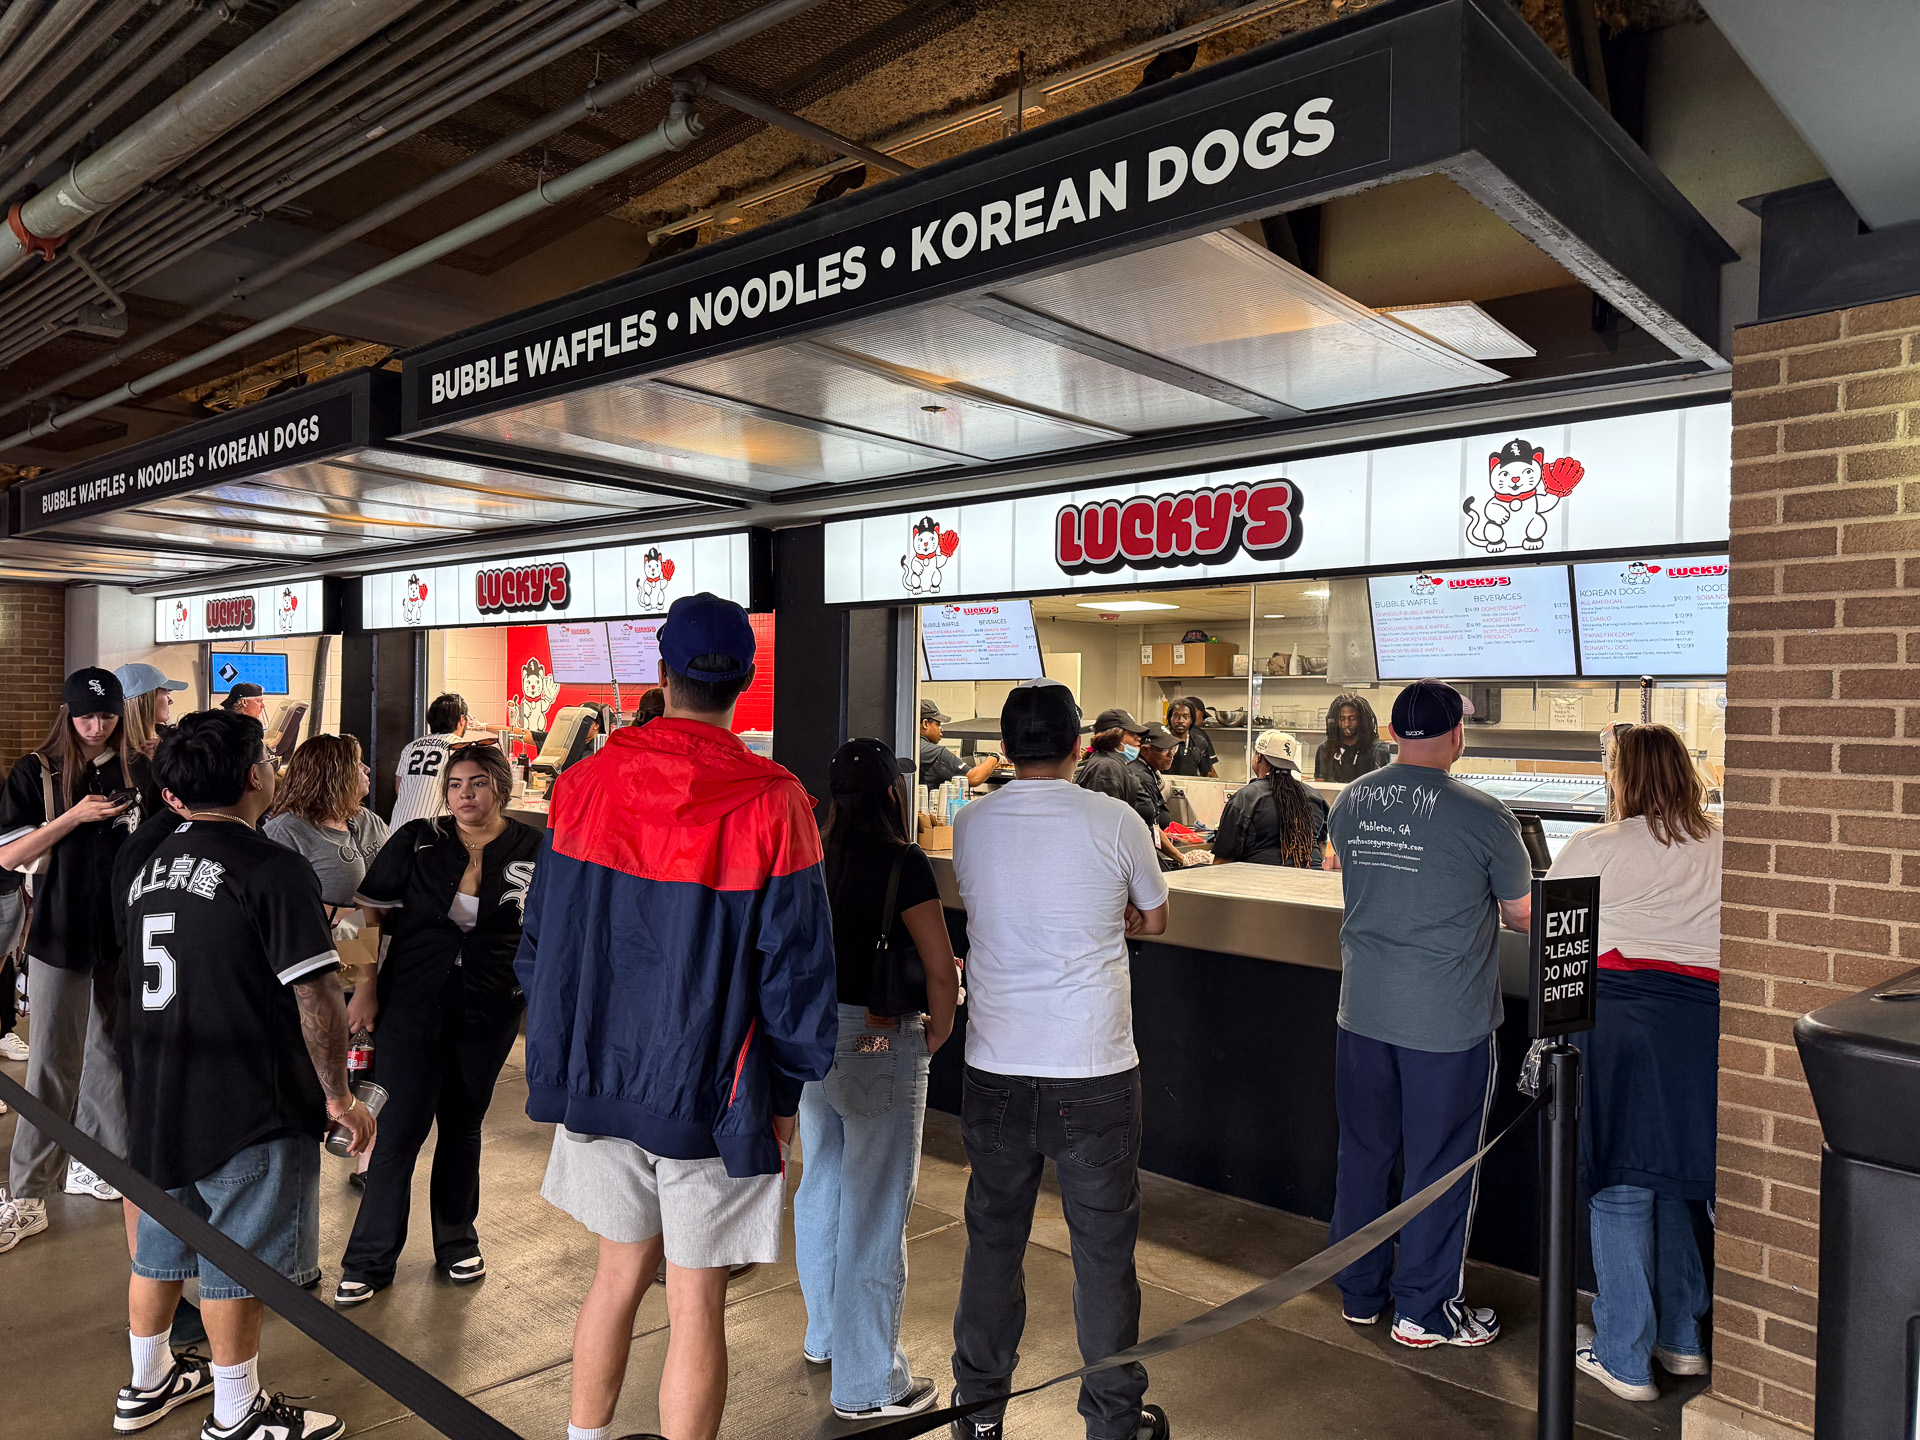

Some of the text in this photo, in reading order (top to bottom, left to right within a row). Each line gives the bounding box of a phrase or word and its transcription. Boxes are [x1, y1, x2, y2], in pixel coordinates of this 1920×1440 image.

[432, 97, 1335, 404] BUBBLE WAFFLES NOODLES KOREAN DOGS
[42, 414, 320, 514] BUBBLE WAFFLES NOODLES KOREAN DOGS
[1057, 480, 1295, 567] LUCKY'S
[1448, 576, 1510, 589] LUCKY'S
[1667, 565, 1729, 578] LUCKY'
[476, 562, 569, 613] LUCKY'S
[1474, 593, 1522, 602] BEVERAGES
[1580, 587, 1646, 597] KOREAN DOGS
[1697, 584, 1728, 592] NOOD
[206, 595, 254, 631] LUCKY'S
[1375, 598, 1438, 608] BUBBLE WAFFLE
[408, 750, 442, 776] 22
[1347, 782, 1441, 821] MADHOUSE GYM
[1359, 820, 1411, 836] Mableton, GA
[1545, 908, 1589, 938] EXIT
[142, 912, 177, 1011] 5
[1563, 960, 1589, 979] NOT
[1543, 981, 1584, 1003] ENTER
